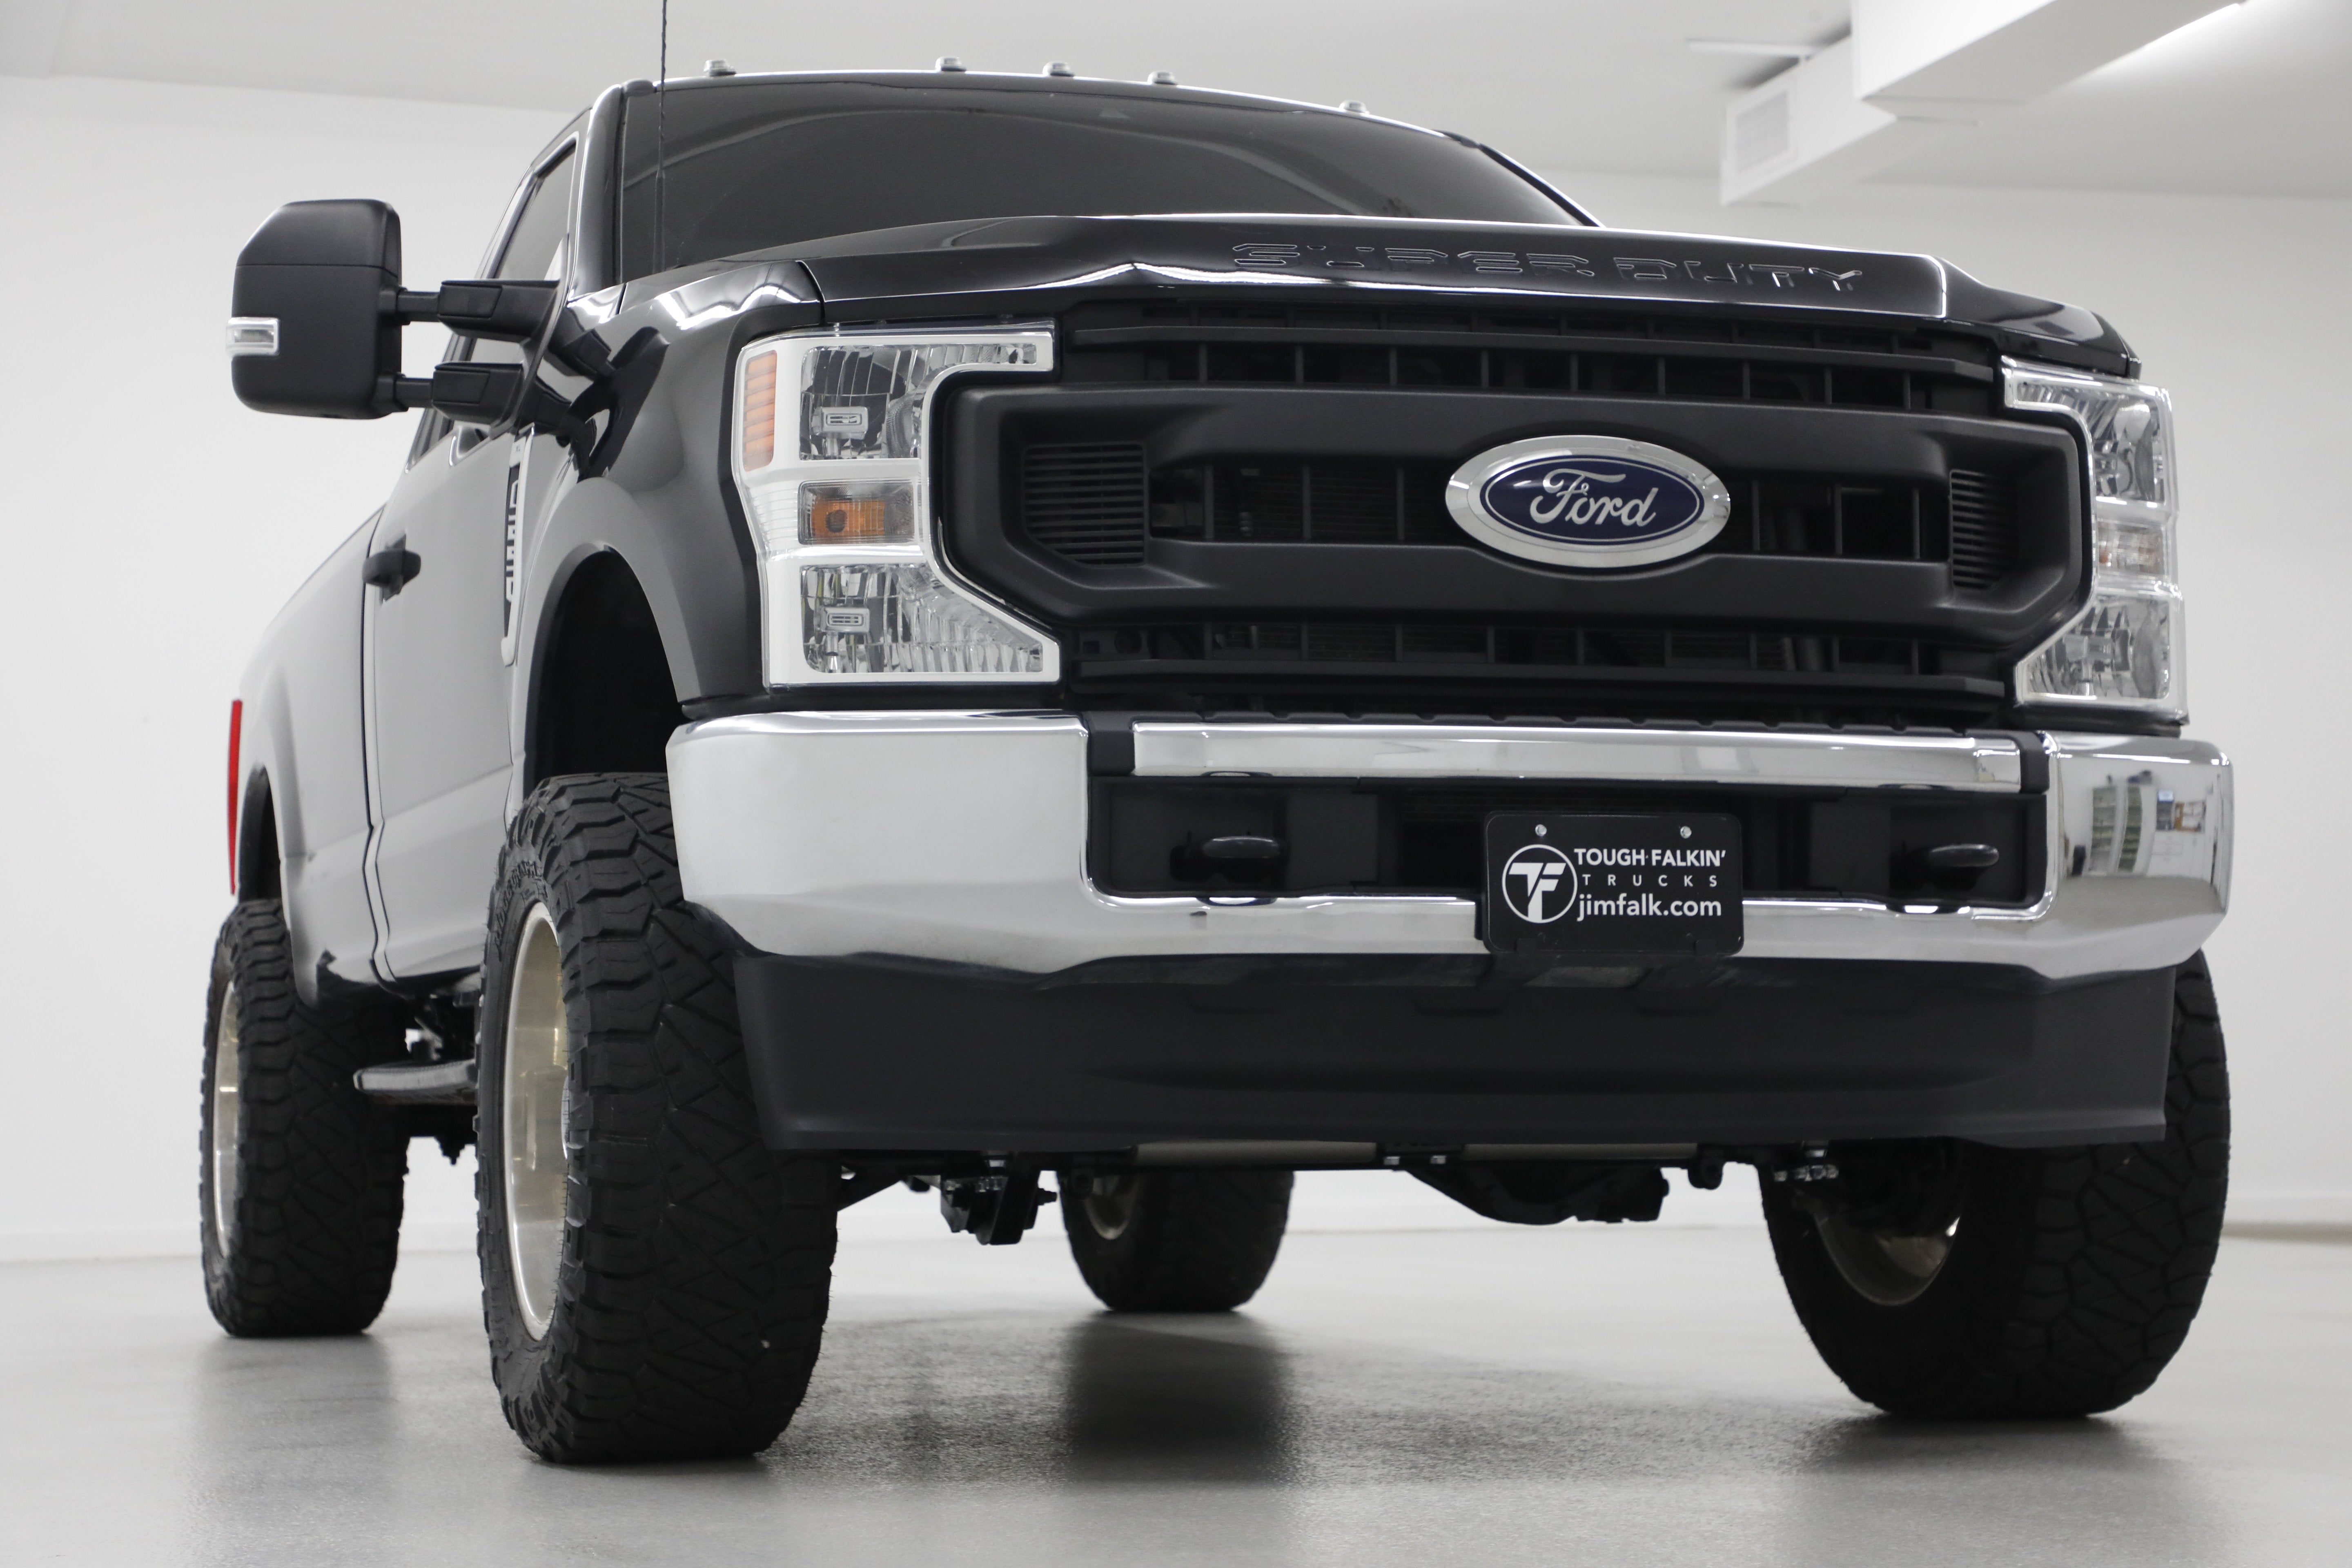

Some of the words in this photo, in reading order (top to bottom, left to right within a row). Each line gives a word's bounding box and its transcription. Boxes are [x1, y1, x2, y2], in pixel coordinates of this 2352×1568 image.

[1232, 243, 1595, 278] SUPER
[1613, 257, 1863, 291] DUTY
[1530, 468, 1658, 526] Ford
[1574, 848, 1645, 866] TOUGH
[1651, 849, 1726, 867] FALKIN'
[1582, 874, 1717, 887] TRUCKS
[1577, 893, 1722, 922] jimfalk.com
